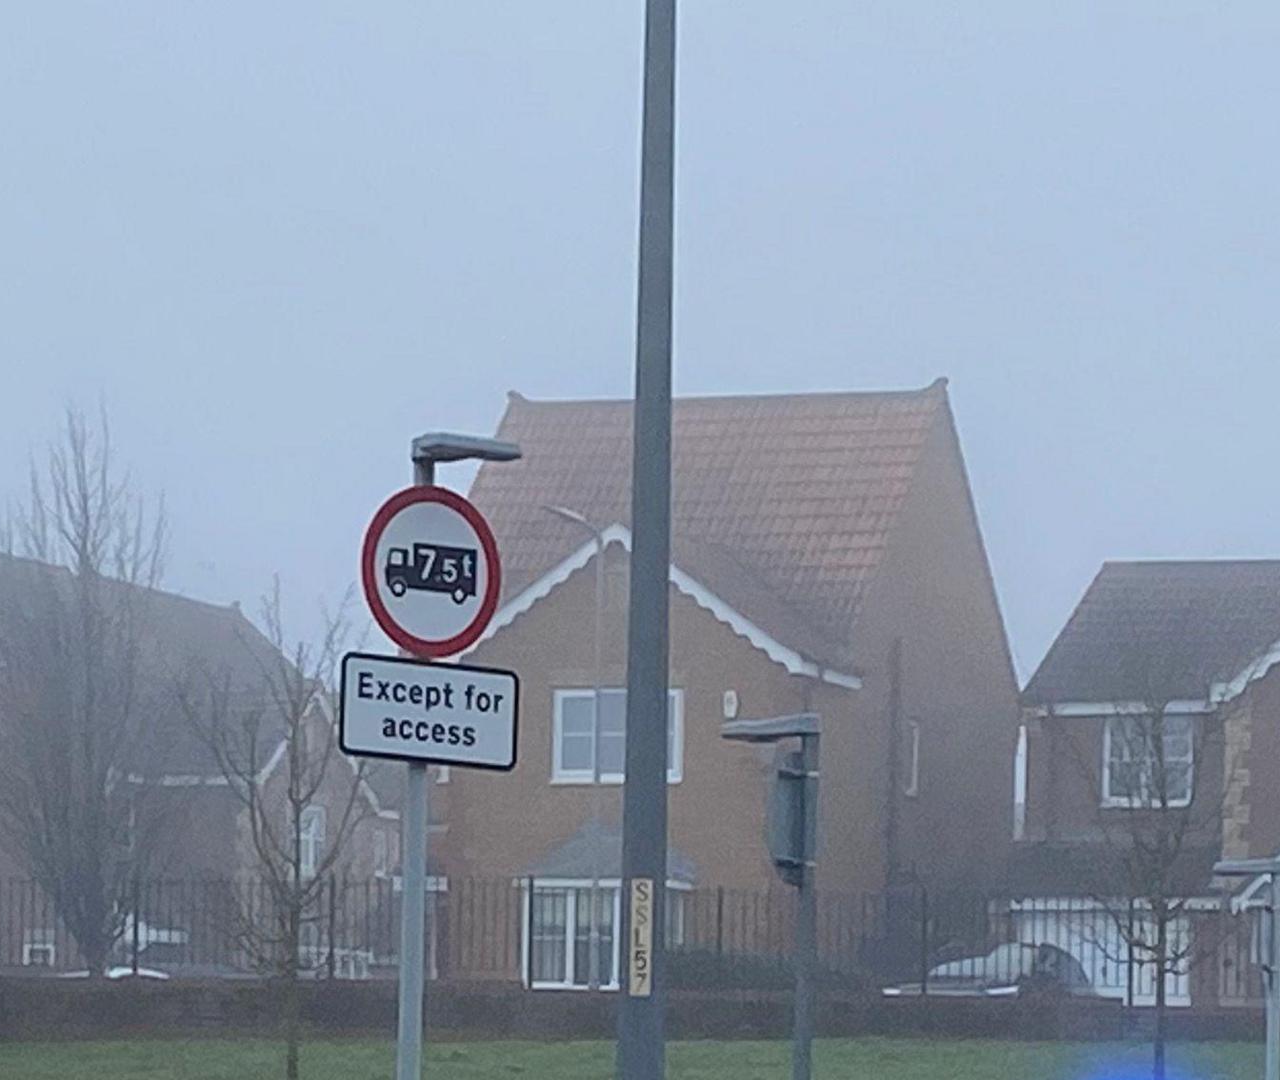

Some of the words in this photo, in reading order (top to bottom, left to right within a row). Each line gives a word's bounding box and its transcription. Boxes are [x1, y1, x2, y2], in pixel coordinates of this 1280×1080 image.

[358, 672, 454, 711] Except
[465, 684, 504, 713] for
[382, 717, 476, 746] access
